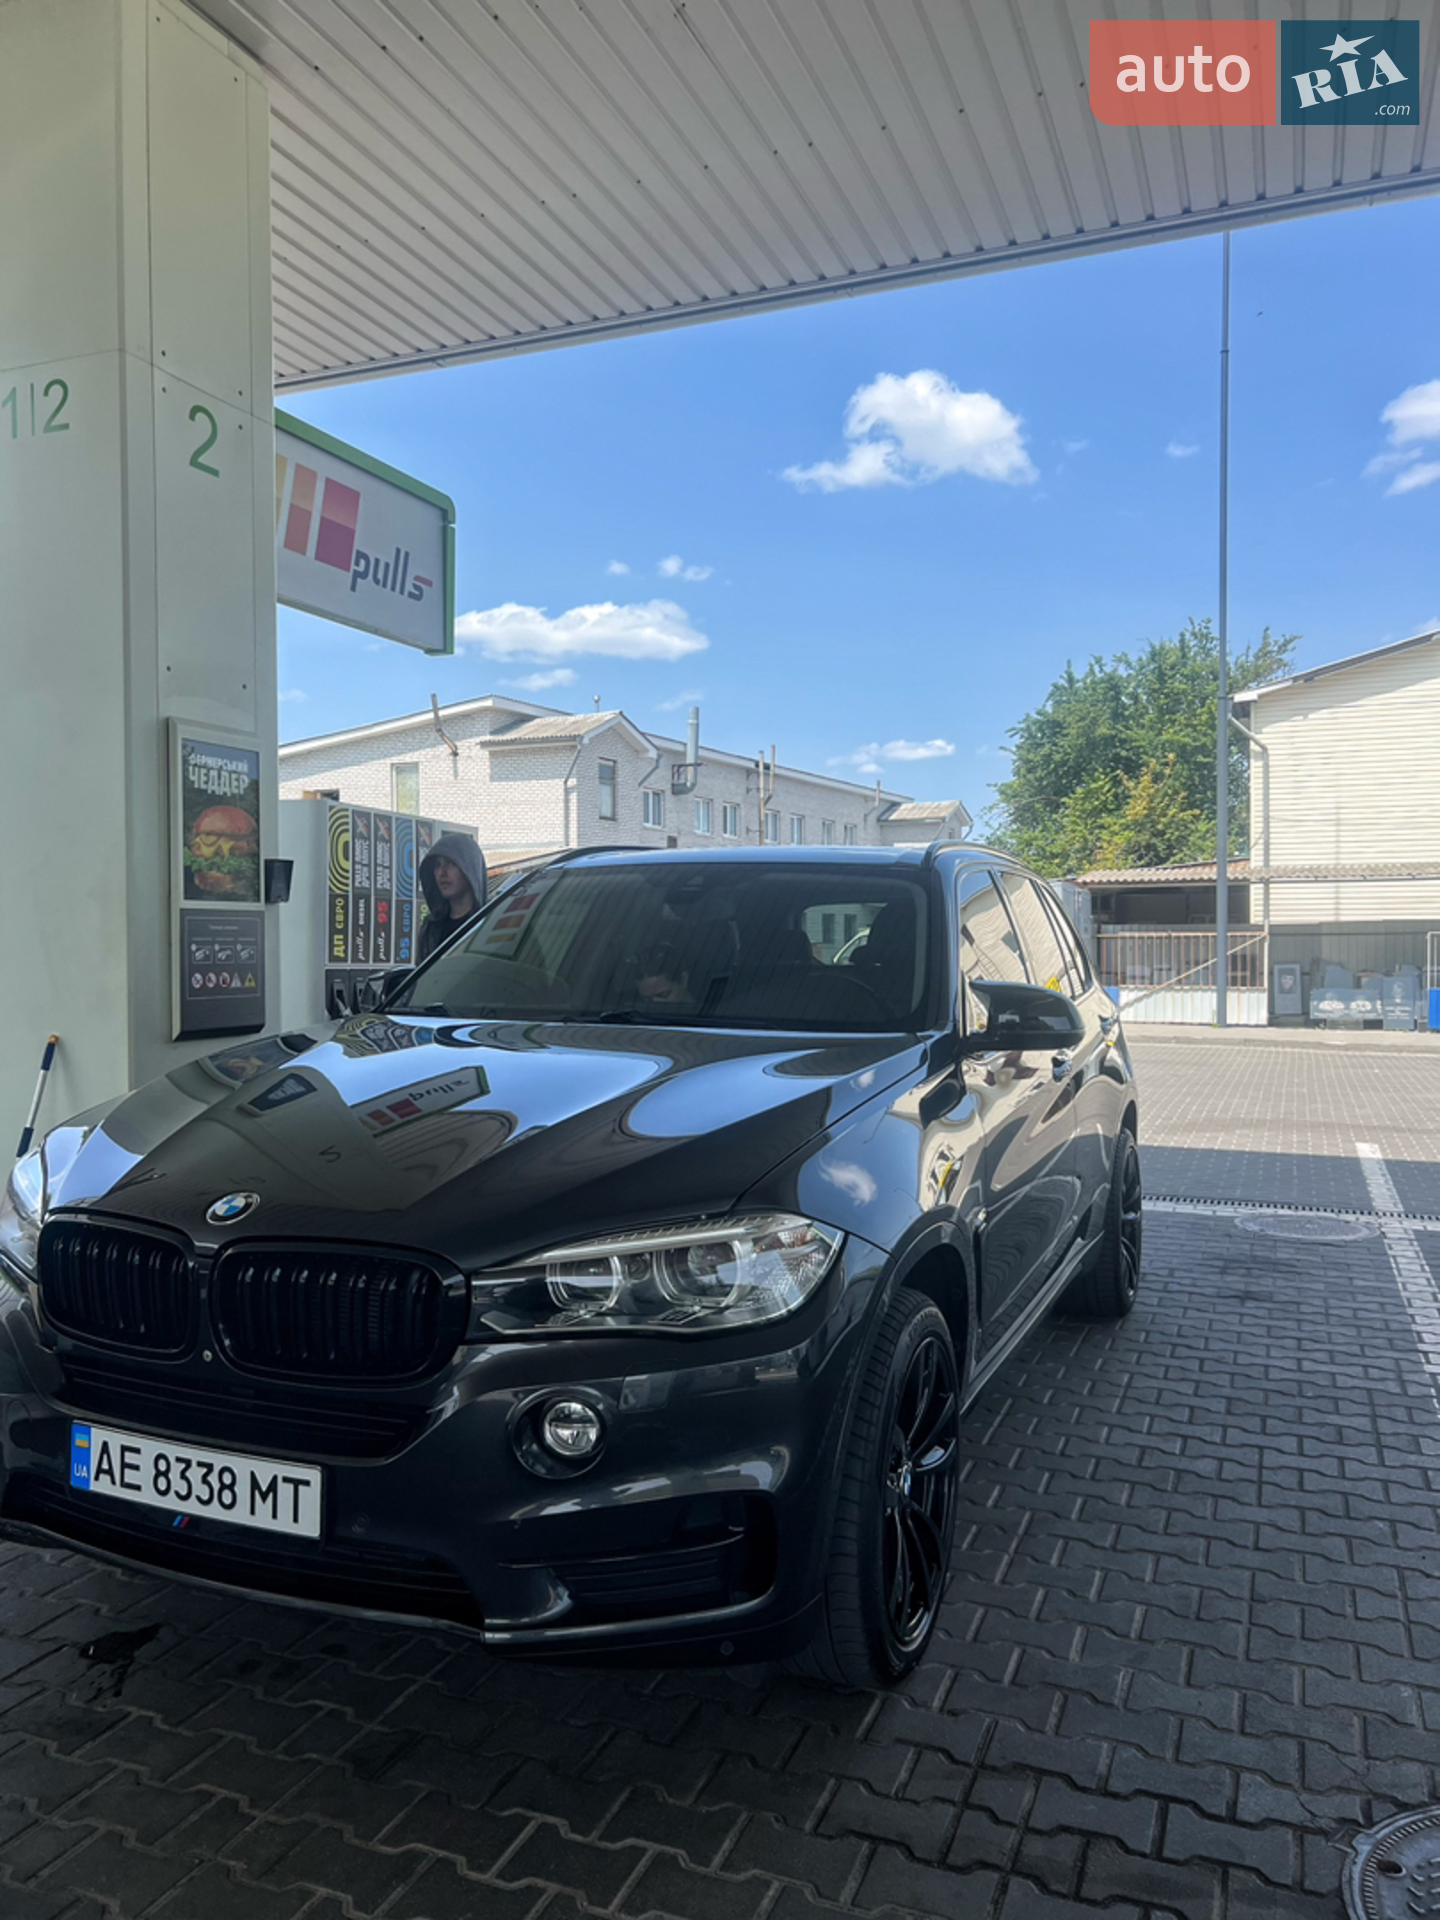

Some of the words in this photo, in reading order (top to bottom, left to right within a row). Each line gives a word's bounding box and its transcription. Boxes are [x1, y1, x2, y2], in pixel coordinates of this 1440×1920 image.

[188, 404, 220, 478] 2
[350, 547, 433, 602] pulls
[188, 752, 248, 773] ФЕРМЕРСЬКИЙ
[188, 766, 250, 797] ЧЕДДЕР
[400, 937, 410, 960] 95
[73, 1462, 89, 1479] UA
[93, 1440, 142, 1492] AE
[152, 1453, 238, 1511] 8338
[249, 1469, 312, 1524] MT
